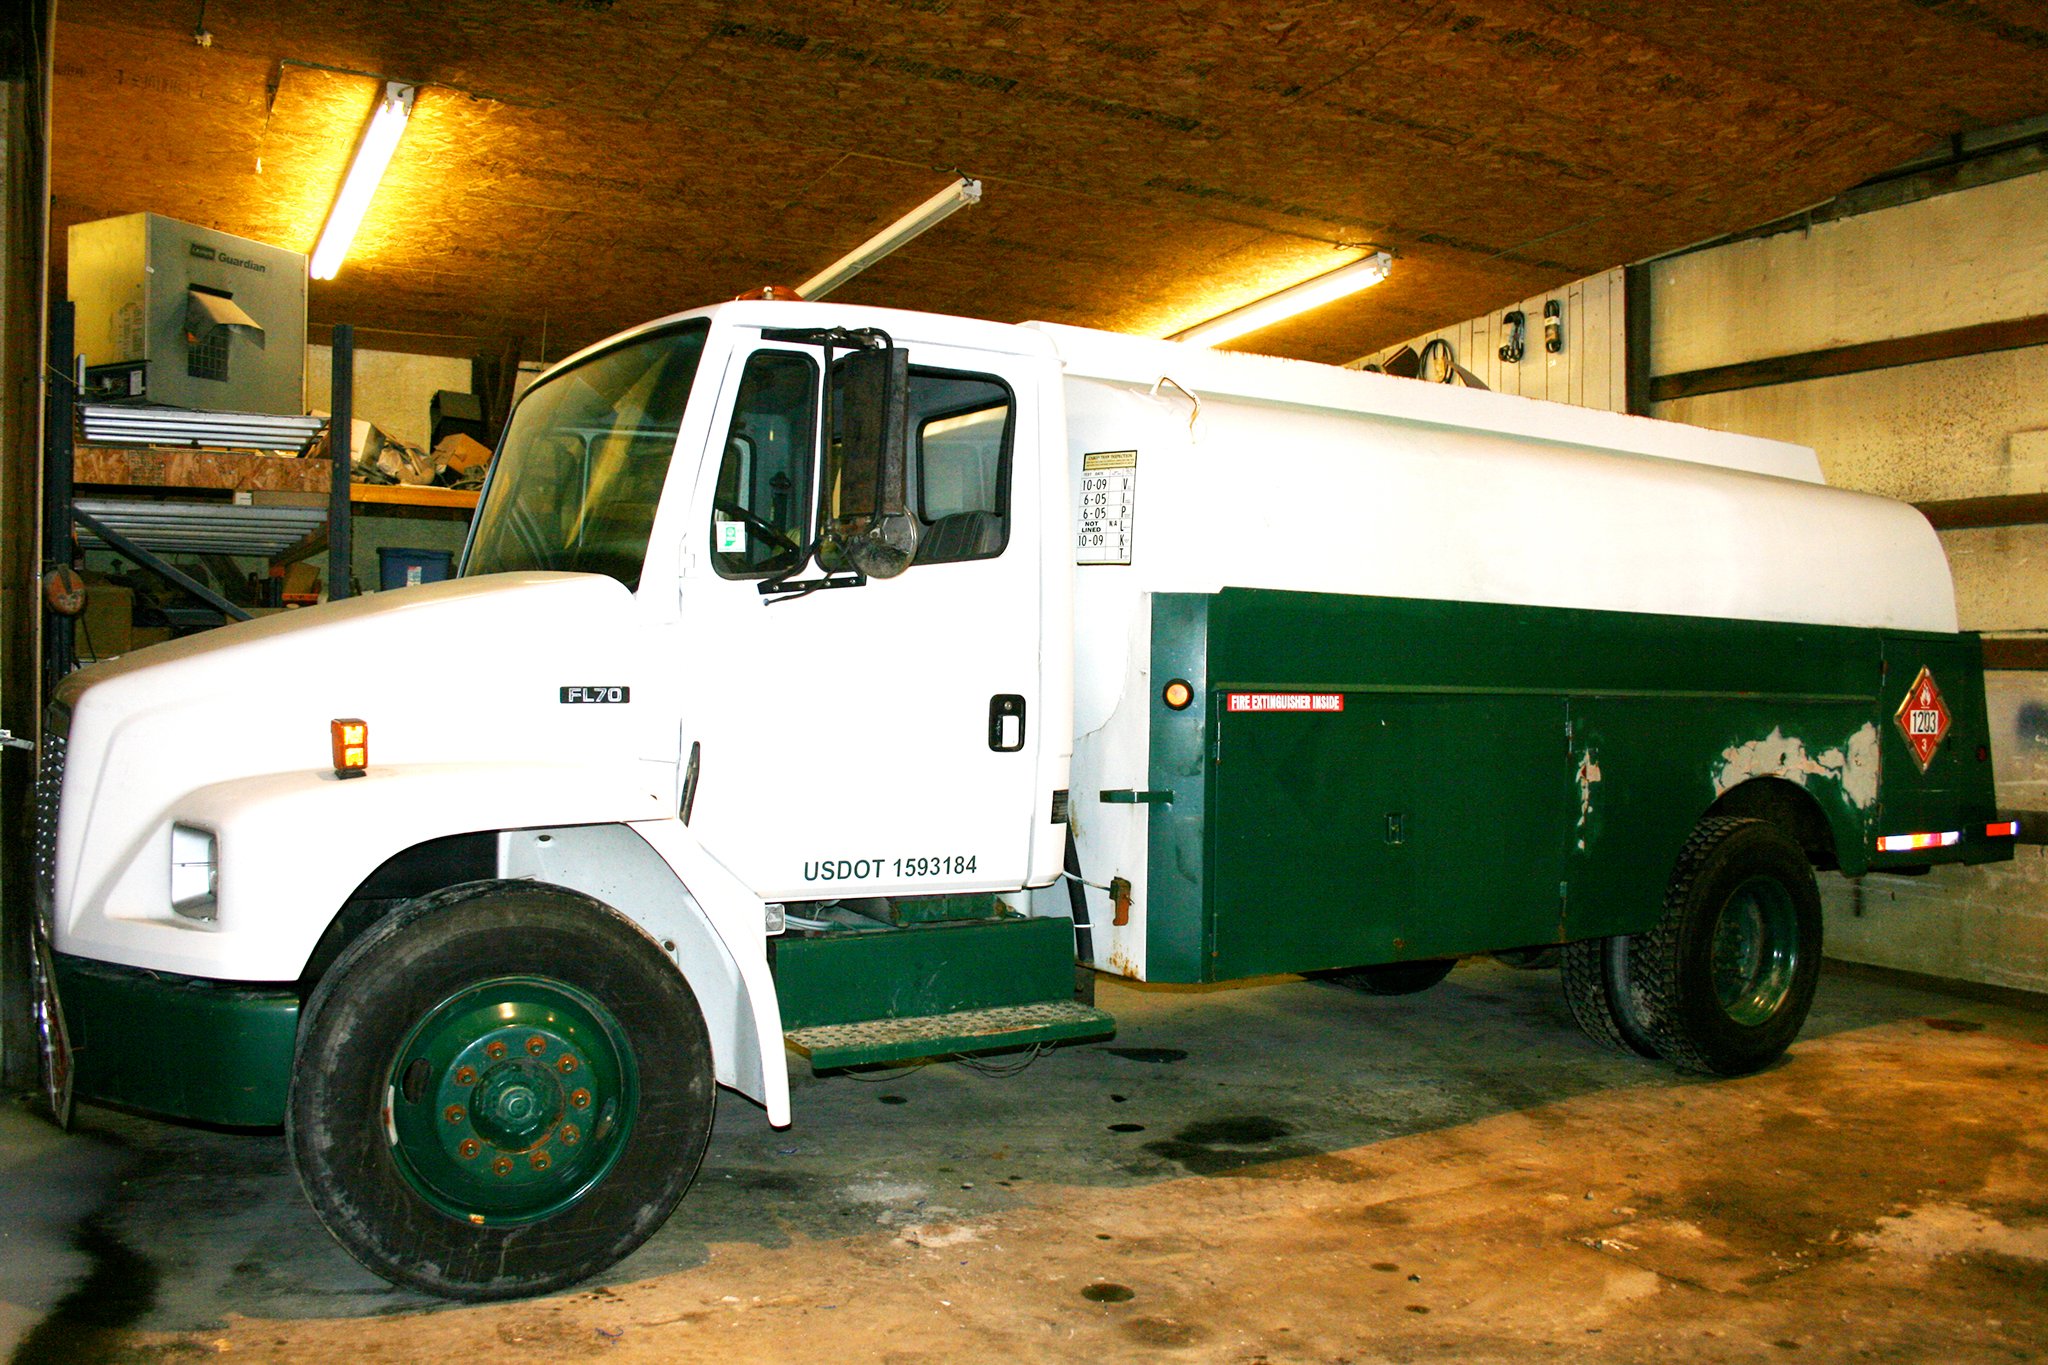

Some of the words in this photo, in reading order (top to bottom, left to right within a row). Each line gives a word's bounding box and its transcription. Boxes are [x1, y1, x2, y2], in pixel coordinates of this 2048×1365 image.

[218, 252, 266, 273] Guardian
[1123, 477, 1128, 490] V
[1121, 505, 1126, 518] P
[1120, 520, 1124, 531] L
[1120, 534, 1124, 546] K
[1119, 548, 1124, 559] T
[568, 687, 622, 703] FL70
[1231, 695, 1251, 710] FIRE
[1252, 695, 1311, 709] EXTINGUISHER
[1312, 695, 1340, 709] INSIDE
[1912, 711, 1937, 733] 1203
[1921, 738, 1927, 753] 3
[804, 859, 886, 881] USDOT
[893, 855, 977, 877] 1593184
